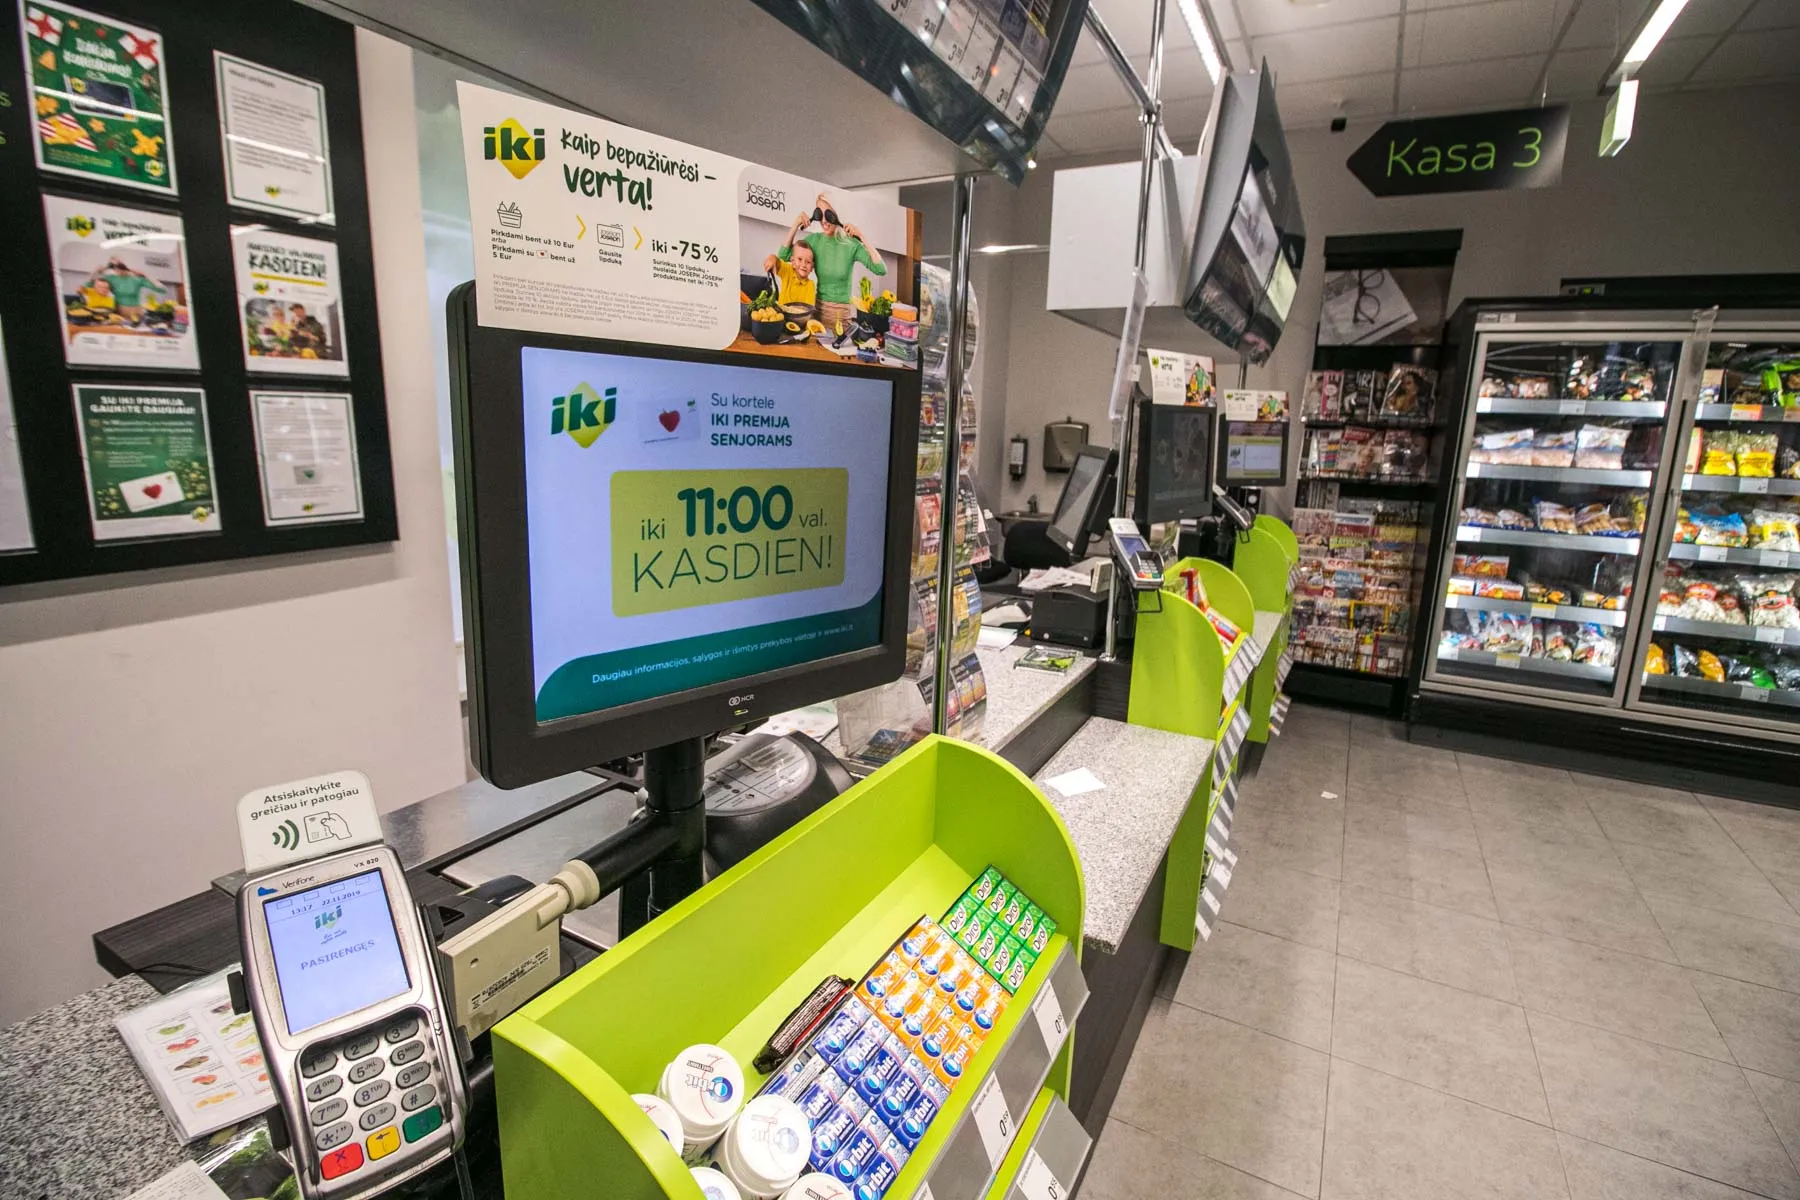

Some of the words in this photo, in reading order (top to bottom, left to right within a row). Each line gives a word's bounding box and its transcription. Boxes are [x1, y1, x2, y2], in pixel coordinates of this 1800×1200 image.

[484, 126, 545, 160] iki
[1387, 138, 1496, 177] Kasa
[1513, 127, 1543, 168] 3
[560, 128, 600, 159] Kaip
[606, 139, 699, 182] bepažiūrėsi
[563, 163, 653, 211] verta!
[746, 192, 786, 212] Joseph
[491, 229, 523, 241] Pirkdami
[525, 236, 542, 244] bent
[652, 239, 668, 254] iki
[492, 244, 525, 255] Pirkdami
[550, 254, 566, 262] bent
[599, 249, 622, 259] Gausite
[653, 259, 677, 268] Surinkus
[653, 272, 686, 284] produktams
[679, 270, 700, 278] JOSEPH
[551, 387, 617, 436] iki
[711, 392, 728, 407] Su
[733, 393, 775, 409] kortele
[711, 414, 729, 428] IKI
[734, 414, 790, 429] PREMIJA
[711, 433, 793, 447] SENJORAMS
[641, 518, 666, 542] iki
[677, 484, 794, 538] 11:00
[800, 508, 828, 528] val.
[634, 534, 833, 593] KASDIEN!
[592, 667, 633, 684] Daugiau
[634, 657, 691, 674] informacijos,
[693, 649, 724, 664] sąlygos
[724, 647, 731, 656] ir
[732, 642, 759, 656] išimtys
[760, 636, 793, 651] prekybos
[741, 694, 755, 702] NCR
[263, 781, 341, 804] Atsiskaitykite
[250, 802, 297, 821] greičiau
[311, 788, 359, 807] patogiau
[366, 857, 379, 865] 820
[321, 890, 361, 906] 22.11.2019
[977, 877, 990, 898] Dirol
[990, 889, 1005, 912] Dirol
[314, 905, 343, 929] iki
[950, 907, 965, 931] Dirol
[1005, 901, 1019, 924] Dirol
[965, 918, 980, 944] Dirol
[1018, 914, 1033, 937] Dirol
[980, 932, 994, 958] Dirol
[1033, 926, 1047, 951] Dirol
[994, 946, 1009, 972] Dirol
[1009, 960, 1024, 986] Dirol
[392, 1029, 400, 1039] 3
[350, 1044, 359, 1055] 2
[397, 1050, 405, 1060] 6
[357, 1067, 365, 1078] 5
[402, 1073, 411, 1084] 9
[411, 1067, 423, 1076] WXY
[868, 1054, 896, 1088] Orbit
[314, 1084, 322, 1095] 4
[322, 1079, 334, 1087] GHI
[362, 1090, 370, 1101] 8
[370, 1084, 383, 1093] TUV
[887, 1075, 914, 1111] Orbit
[318, 1108, 326, 1120] 7
[327, 1102, 340, 1111] PRS
[409, 1093, 418, 1106] #
[367, 1114, 376, 1125] 0
[907, 1097, 932, 1133] Orbit
[819, 1112, 850, 1148] Orbit
[840, 1137, 873, 1176] Orbit
[859, 1161, 893, 1200] Orbit
